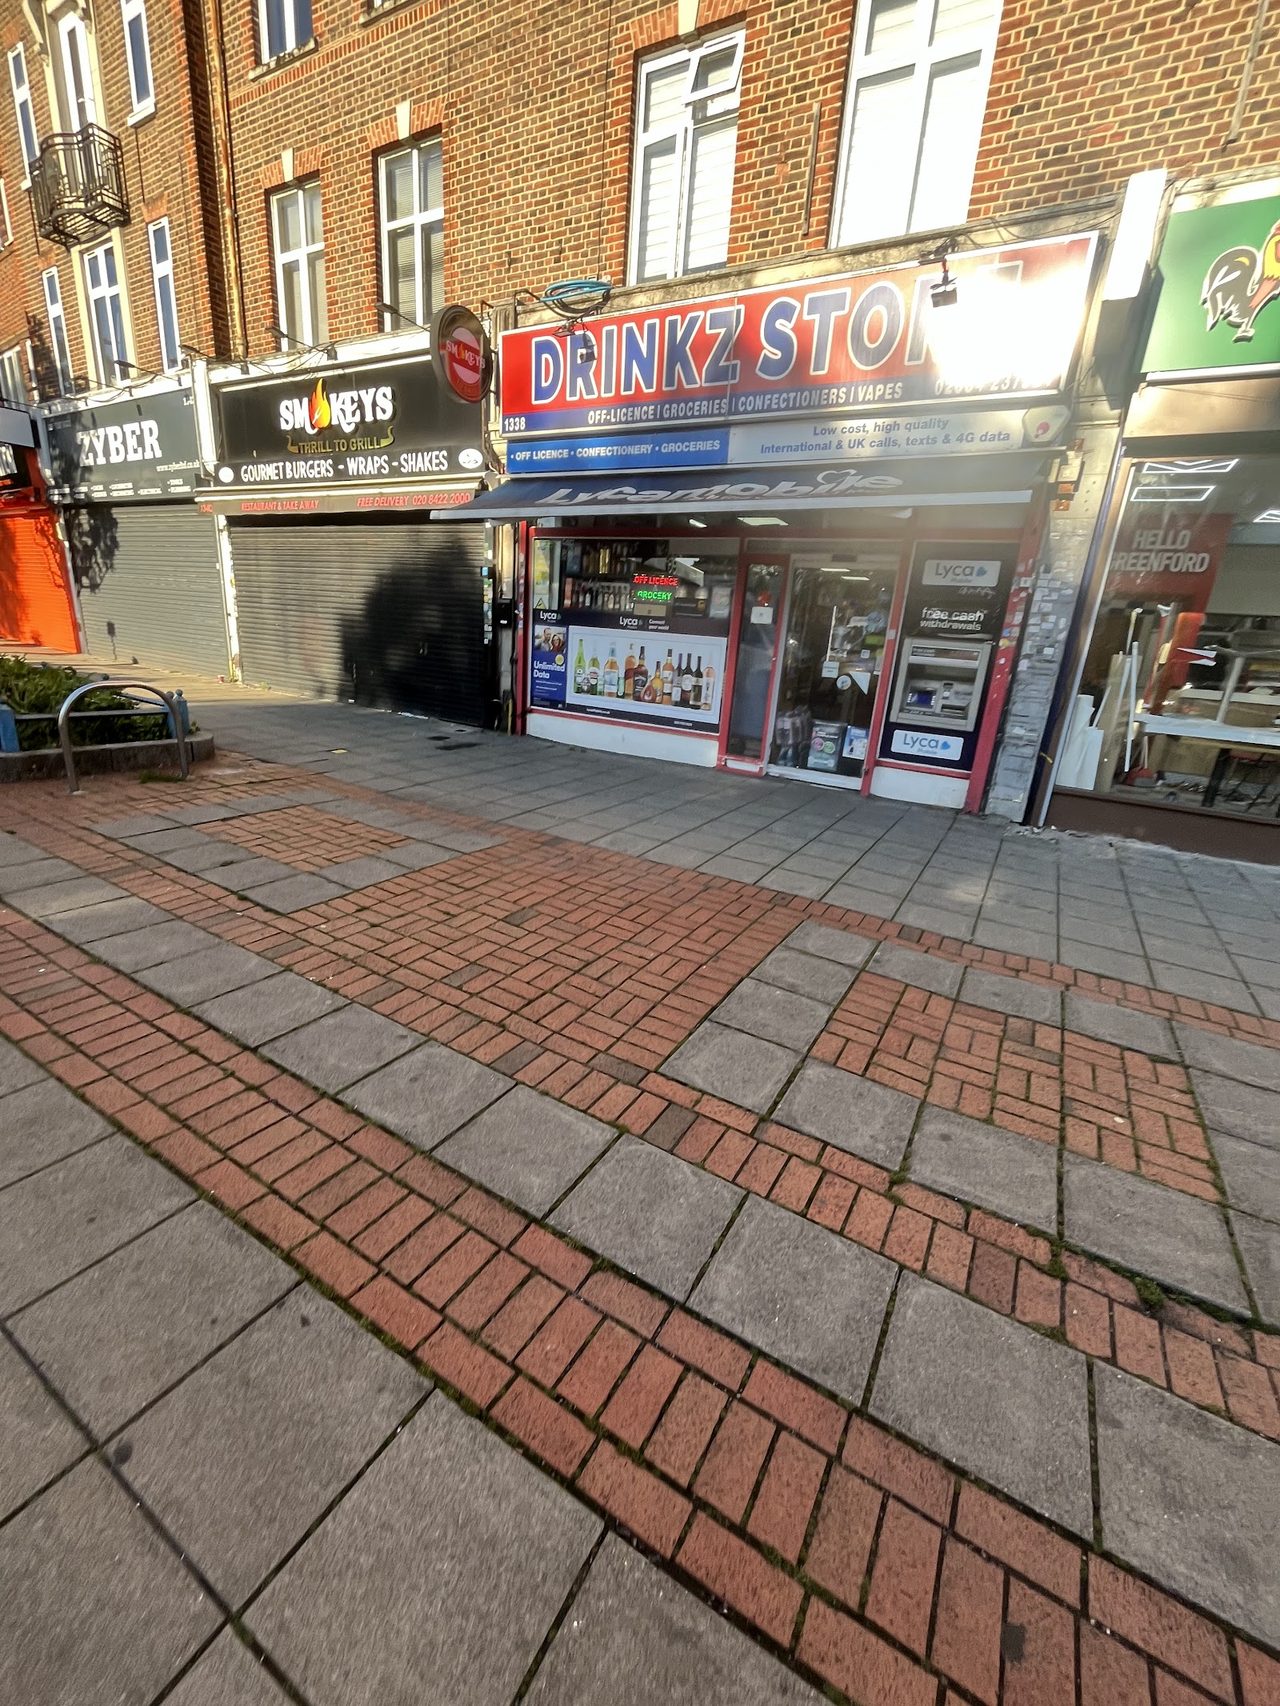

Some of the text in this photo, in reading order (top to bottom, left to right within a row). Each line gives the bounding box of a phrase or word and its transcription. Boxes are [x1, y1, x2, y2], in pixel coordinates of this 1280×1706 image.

[531, 260, 1023, 405] DRINKZ STO
[587, 382, 904, 425] OFF-LICENCE GROCERIES CONFECTIONERS VAPES
[504, 416, 527, 432] 1338
[813, 418, 949, 436] Low cost, high quality
[76, 419, 163, 468] ZYBER
[298, 437, 381, 454] THRILL TO GRILL
[515, 440, 720, 461] OFF LICENCE CONFECTIONERY GROCERIES
[760, 431, 1010, 454] International & UK calls, texts & 4G data
[240, 450, 448, 482] GOURMET BURGERS WRAPS SHAKES
[283, 501, 298, 510] TAKE
[299, 499, 319, 510] AWAY
[357, 492, 471, 507] FREE DELIVERY 020 8422 2000
[1132, 529, 1192, 550] HELLO
[935, 562, 975, 579] Lyca
[633, 575, 648, 584] OFF
[540, 611, 556, 621] Lyca
[620, 616, 638, 626] Lyca
[921, 607, 985, 622] free cash
[920, 620, 982, 631] withdrawals
[533, 660, 565, 672] Unlimited
[533, 669, 550, 679] Data
[903, 733, 939, 749] Lyca
